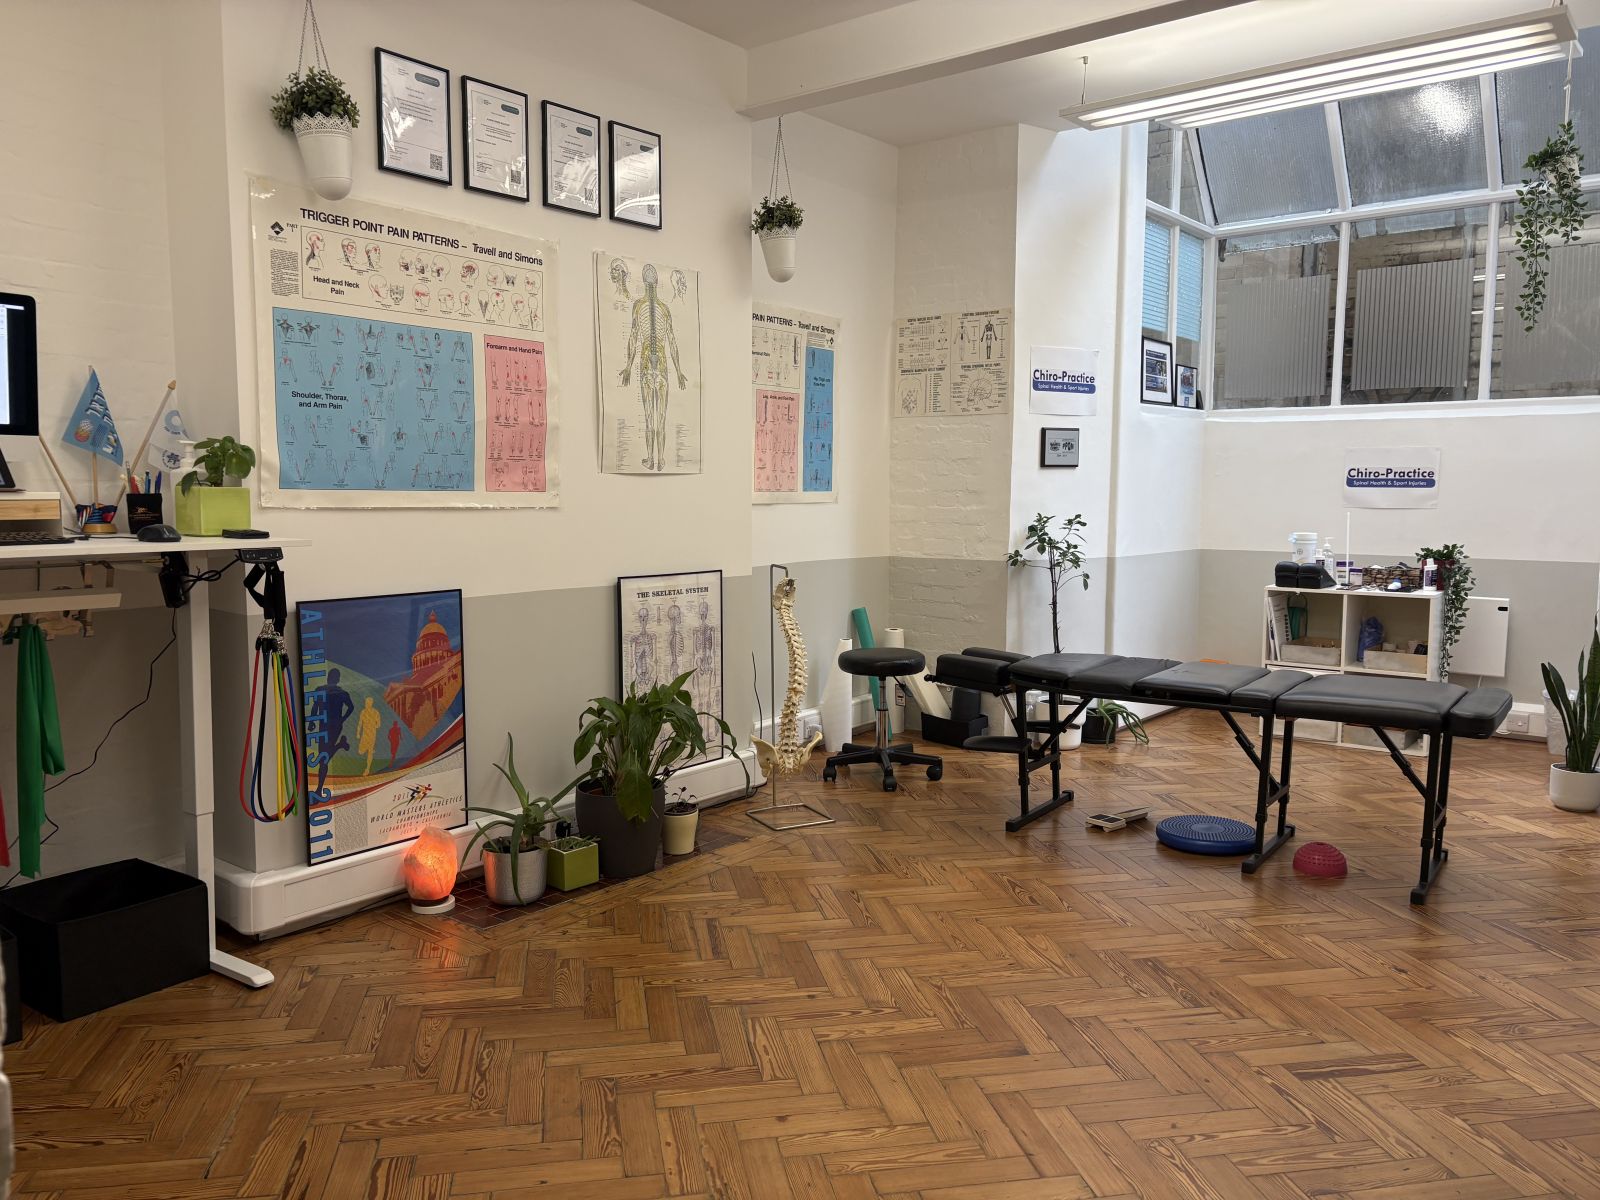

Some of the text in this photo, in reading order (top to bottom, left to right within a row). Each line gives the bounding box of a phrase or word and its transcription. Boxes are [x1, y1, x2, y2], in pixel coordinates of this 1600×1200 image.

[300, 208, 349, 227] TRIGGER
[353, 219, 384, 233] POINT
[387, 226, 409, 239] PAIN
[412, 231, 459, 249] PATTERNS
[472, 243, 496, 256] Travell
[498, 250, 512, 260] and
[514, 252, 543, 266] Simons
[313, 275, 360, 289] Head and Neck
[330, 287, 345, 295] Pain
[752, 313, 765, 322] PAIN
[766, 315, 793, 327] PATTERNS
[798, 321, 811, 330] Travell
[811, 324, 819, 332] and
[820, 325, 835, 335] Simons
[486, 342, 508, 351] Forearm
[1033, 369, 1095, 384] Chiro-Practice
[291, 390, 349, 402] Shoulder, Thorax,
[299, 401, 343, 410] and Arm Pain
[1348, 468, 1435, 478] Chiro-Practice
[637, 586, 709, 599] THE SKELETAL SYSTEM
[300, 609, 329, 769] ATHLETES
[392, 792, 410, 802] 2011
[370, 795, 463, 824] WORLD MASTERS ATHLETICS
[396, 809, 439, 824] CHAMPIONSHIPS
[308, 788, 334, 860] 2011
